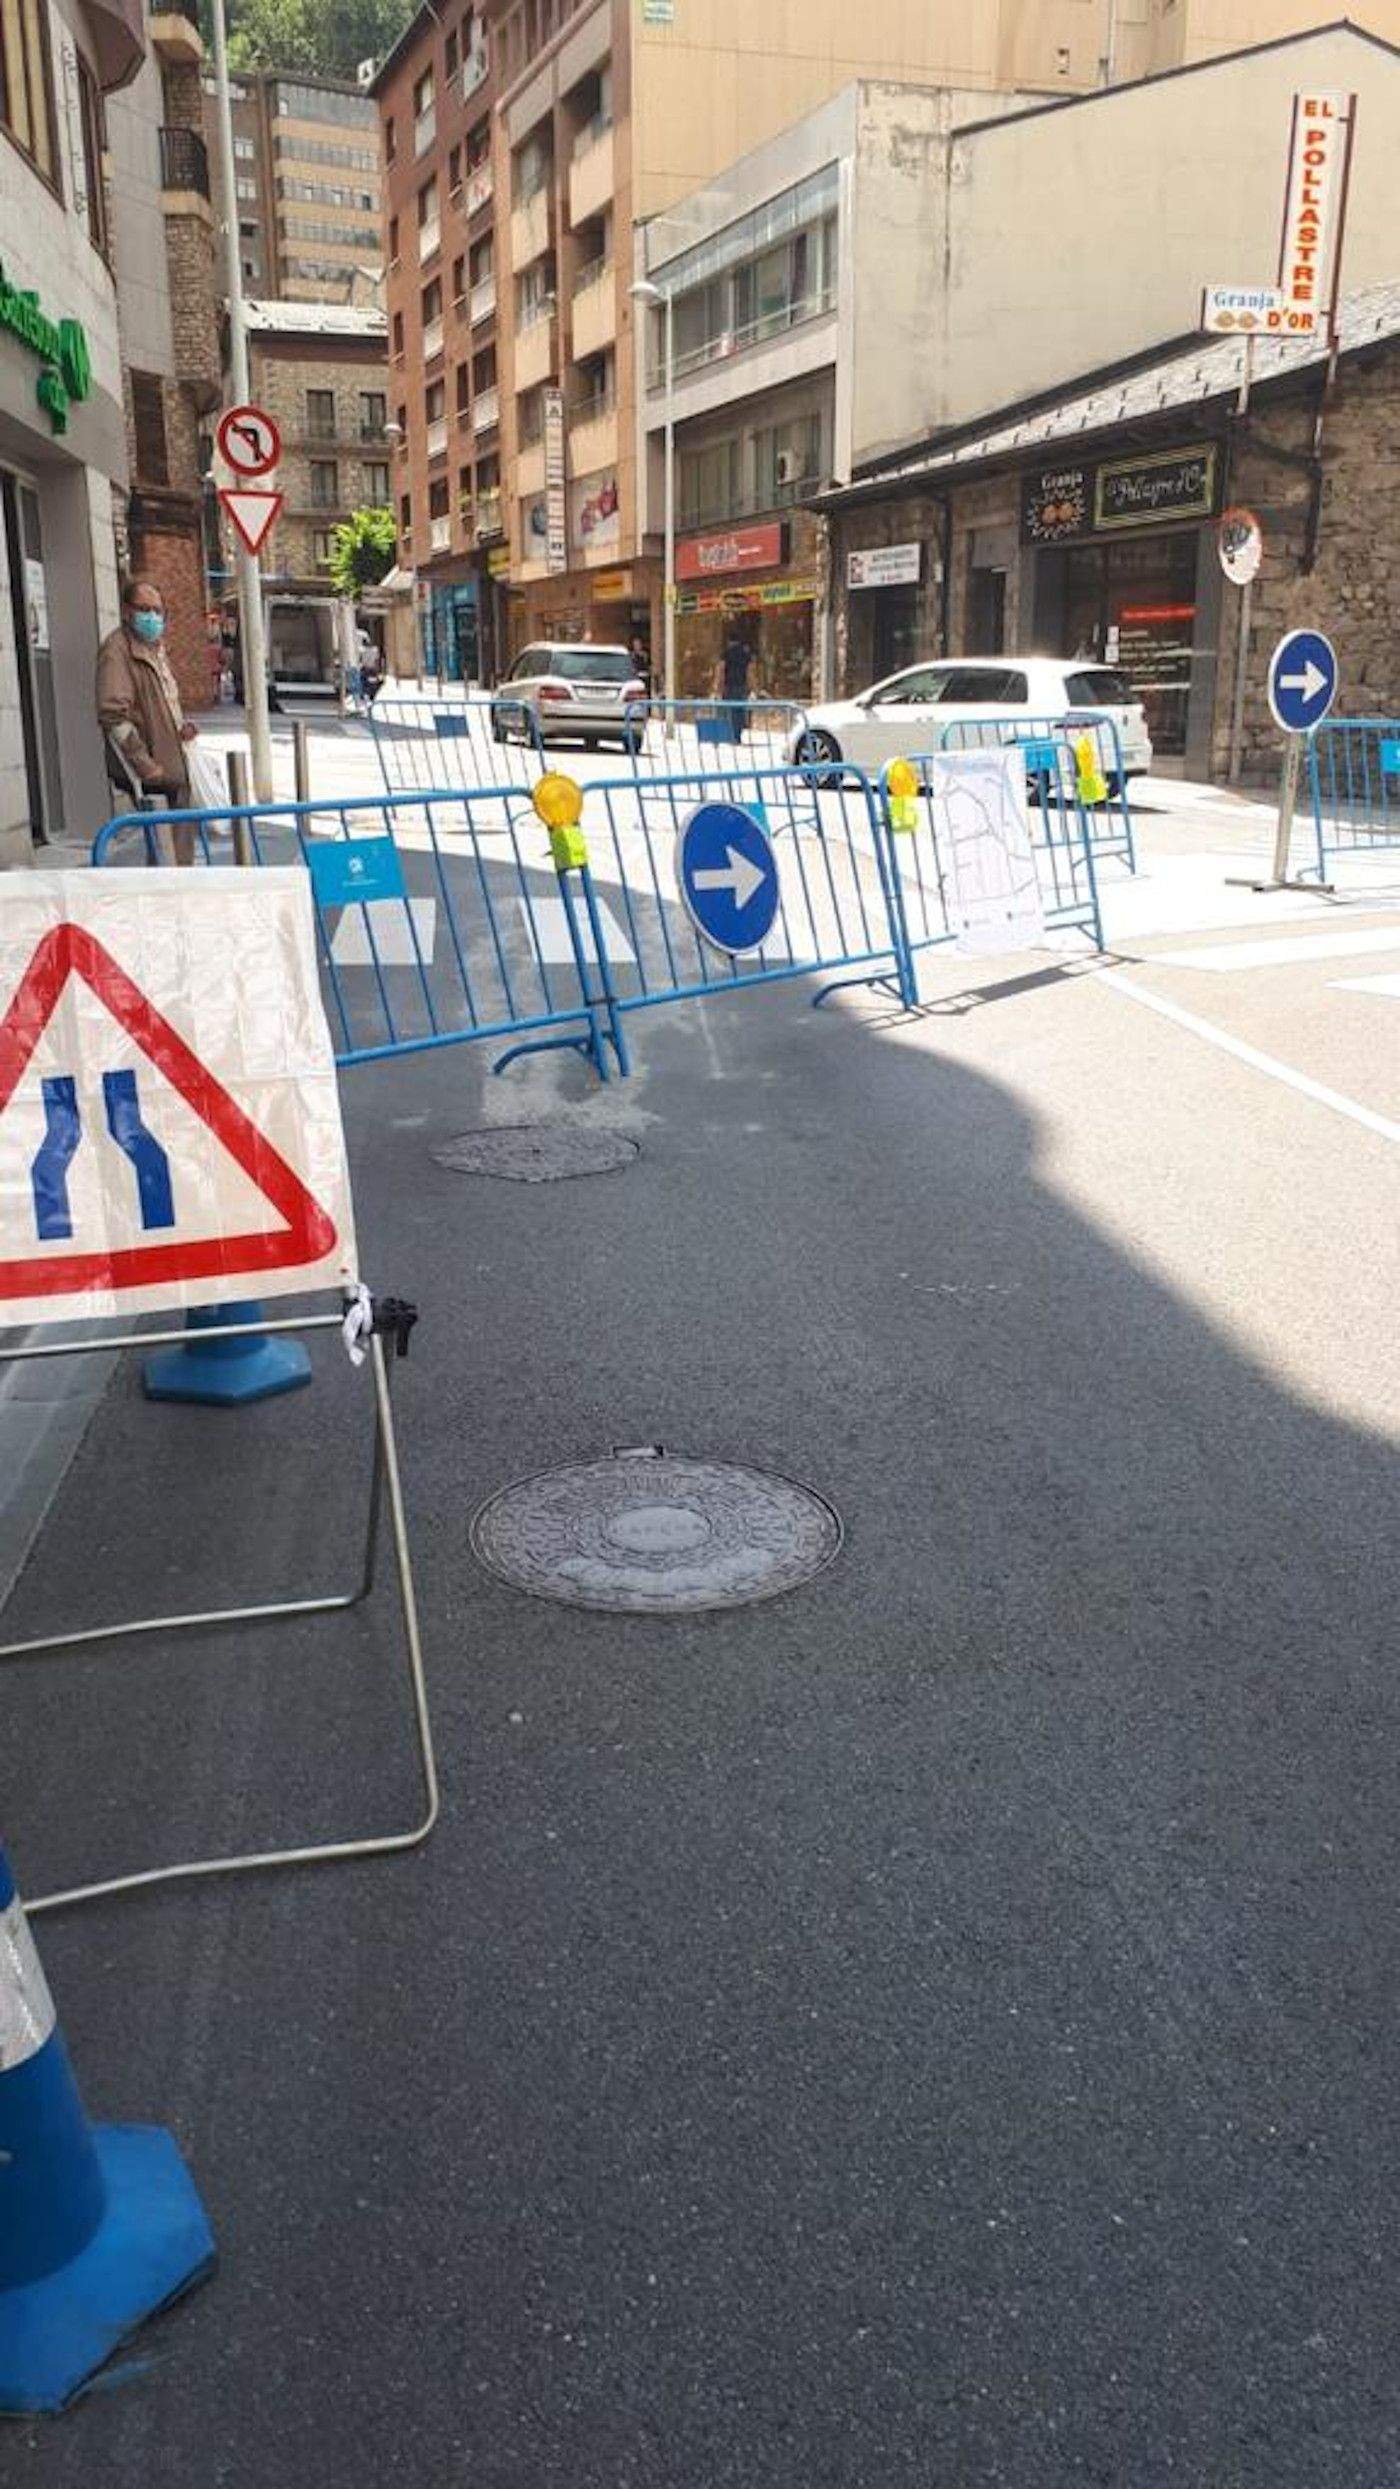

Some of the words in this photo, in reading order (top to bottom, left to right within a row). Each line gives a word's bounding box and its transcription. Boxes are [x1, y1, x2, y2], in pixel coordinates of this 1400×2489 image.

[1304, 99, 1333, 117] EL
[1292, 130, 1326, 300] POLLASTRE
[1213, 291, 1275, 310] Granja
[1267, 307, 1314, 329] D'OR
[1041, 472, 1083, 490] Granja
